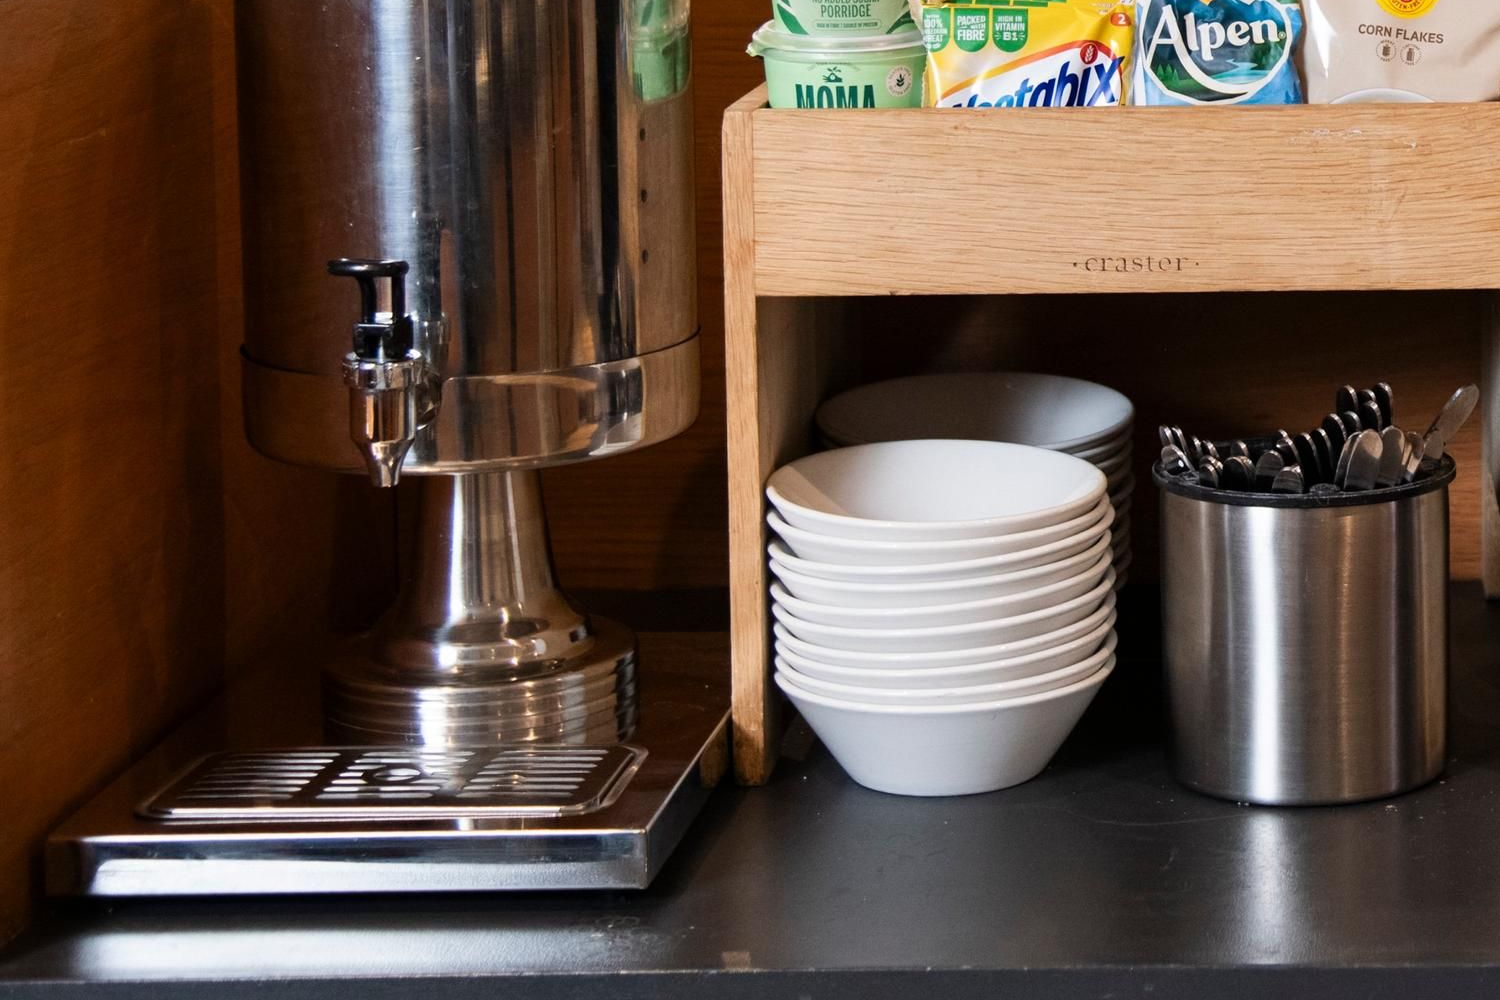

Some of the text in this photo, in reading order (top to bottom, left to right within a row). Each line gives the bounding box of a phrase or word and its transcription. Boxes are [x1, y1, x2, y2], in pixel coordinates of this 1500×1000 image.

[821, 4, 871, 18] PORRIDGE
[957, 15, 986, 26] PACKED
[1118, 14, 1126, 25] 2
[995, 22, 1025, 32] VITAMIN
[957, 30, 985, 40] FIBRE
[1003, 31, 1018, 40] B1
[1145, 4, 1280, 62] Alpen
[1358, 23, 1444, 44] CORN FLAKES
